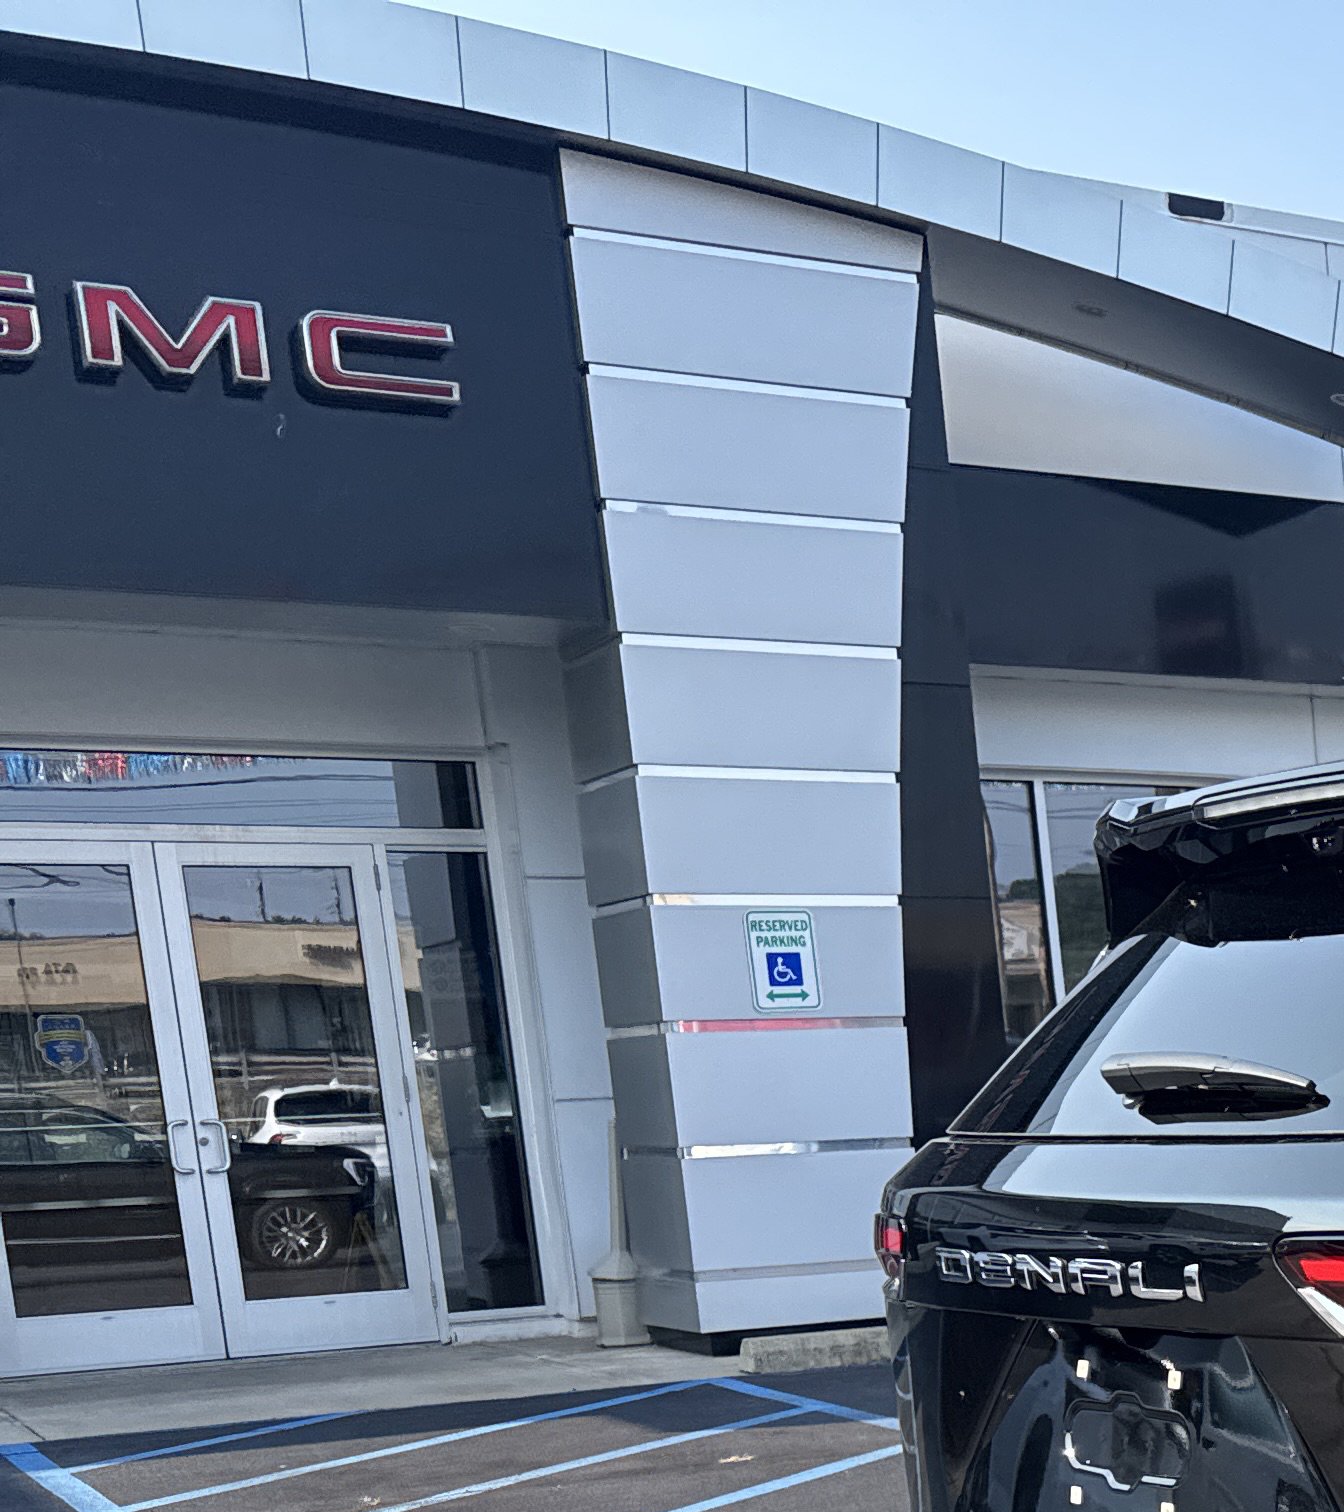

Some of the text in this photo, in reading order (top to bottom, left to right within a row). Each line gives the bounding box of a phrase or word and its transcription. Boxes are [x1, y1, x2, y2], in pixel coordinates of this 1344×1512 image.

[0, 271, 461, 405] MC
[750, 919, 808, 932] RESERVED
[756, 935, 806, 947] PARKING
[935, 1247, 1204, 1302] DENALI
